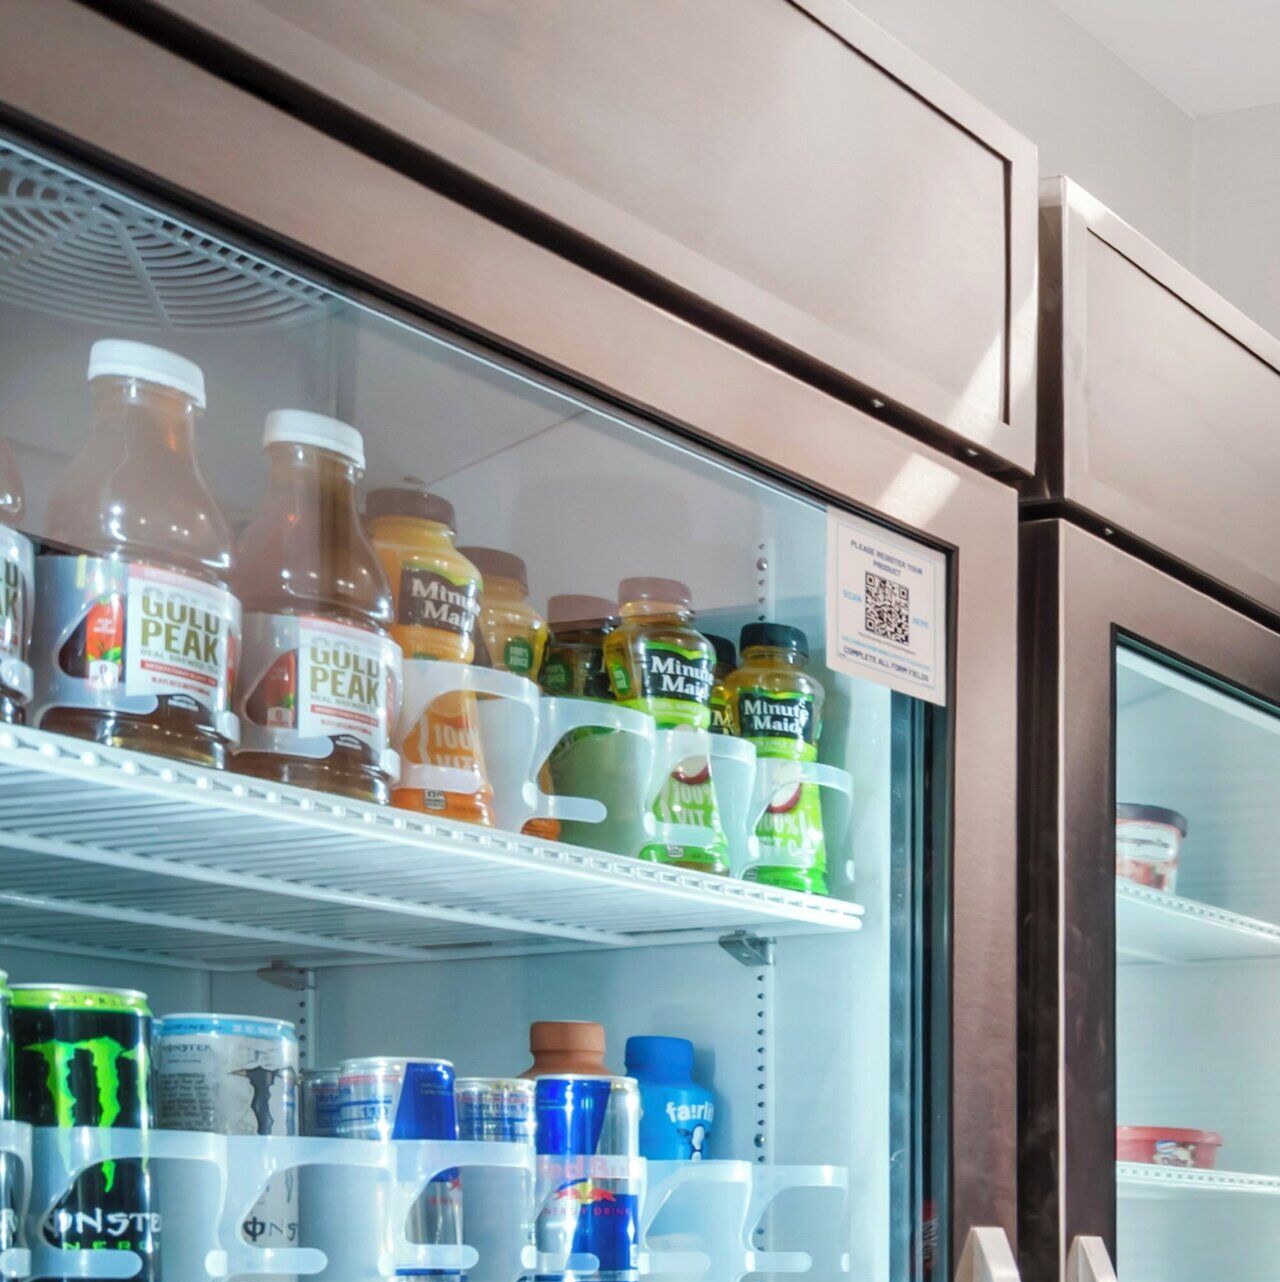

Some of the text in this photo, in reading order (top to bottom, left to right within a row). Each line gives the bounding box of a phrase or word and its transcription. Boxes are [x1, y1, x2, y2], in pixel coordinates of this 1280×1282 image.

[851, 540, 924, 577] PLEASE REGISTER YOUR
[873, 559, 901, 577] PRODUCT
[141, 586, 221, 636] GOLD
[411, 578, 481, 612] Minute
[424, 600, 476, 632] Maid
[140, 619, 219, 666] PEAK
[310, 636, 380, 679] GOLD
[843, 646, 877, 666] COMPLETE
[310, 666, 380, 707] PEAK
[651, 655, 715, 687] Minute
[662, 674, 711, 699] Maid
[744, 699, 809, 722] Minute
[753, 715, 803, 734] Maid
